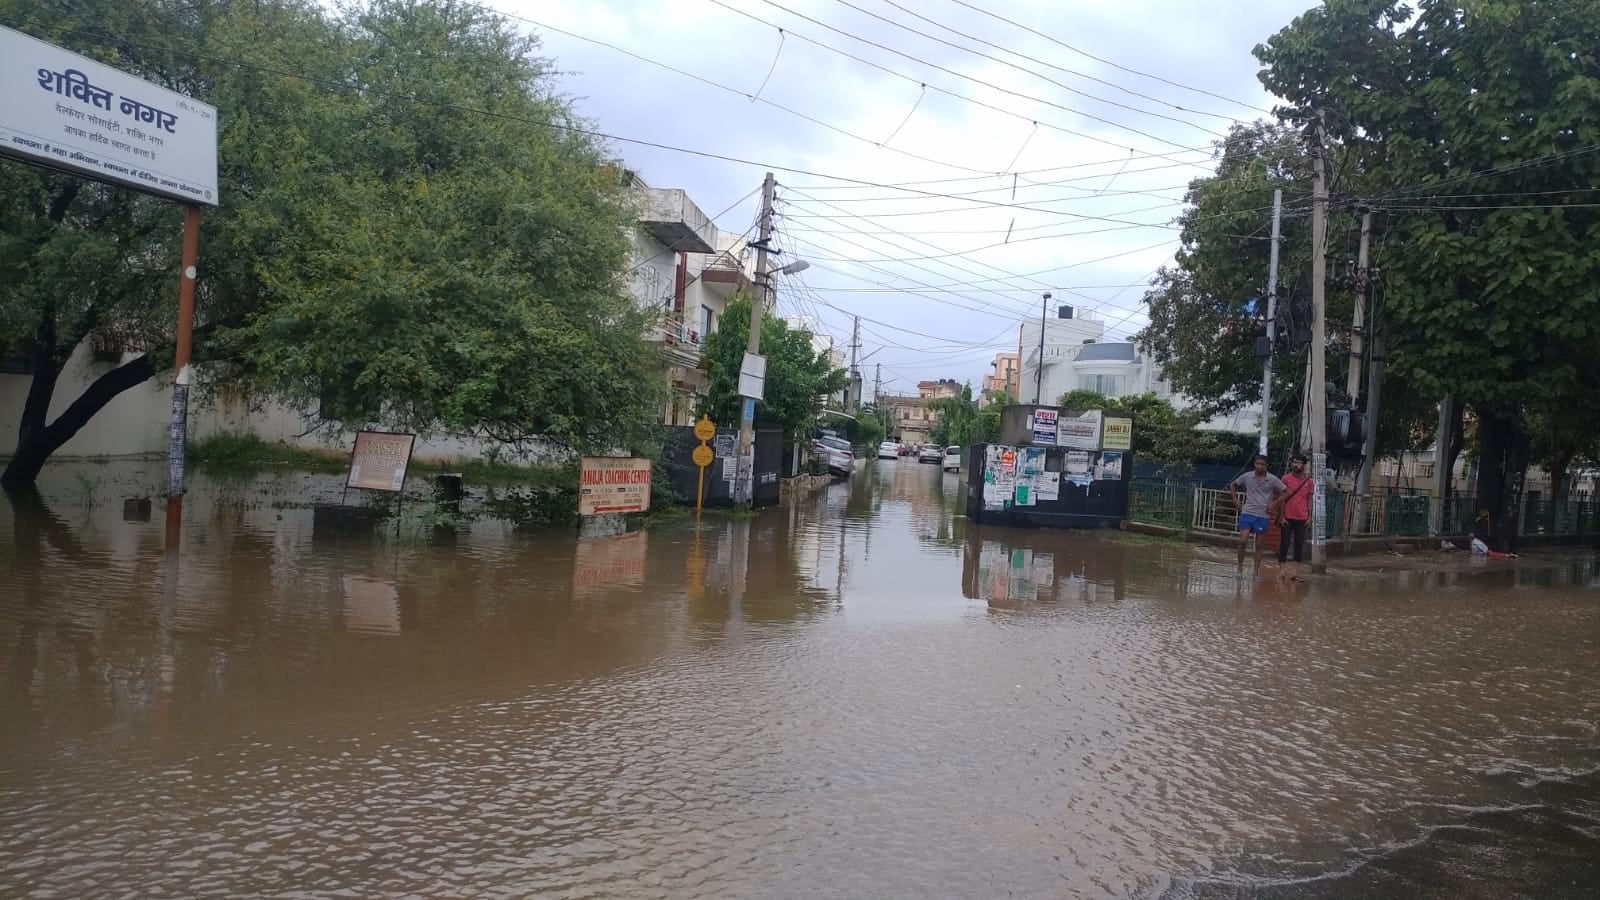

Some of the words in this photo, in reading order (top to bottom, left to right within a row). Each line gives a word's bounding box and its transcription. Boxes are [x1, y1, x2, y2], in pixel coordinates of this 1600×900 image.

[37, 68, 114, 111] शक्ति
[119, 95, 178, 133] नगर
[63, 125, 87, 139] आपका
[111, 139, 131, 153] स्वागत
[125, 127, 146, 144] शक्ति
[148, 135, 164, 147] नगर
[366, 440, 402, 456] YASH
[583, 470, 604, 485] ANUJA
[604, 470, 631, 485] COACHING
[631, 470, 651, 484] CENTRE
